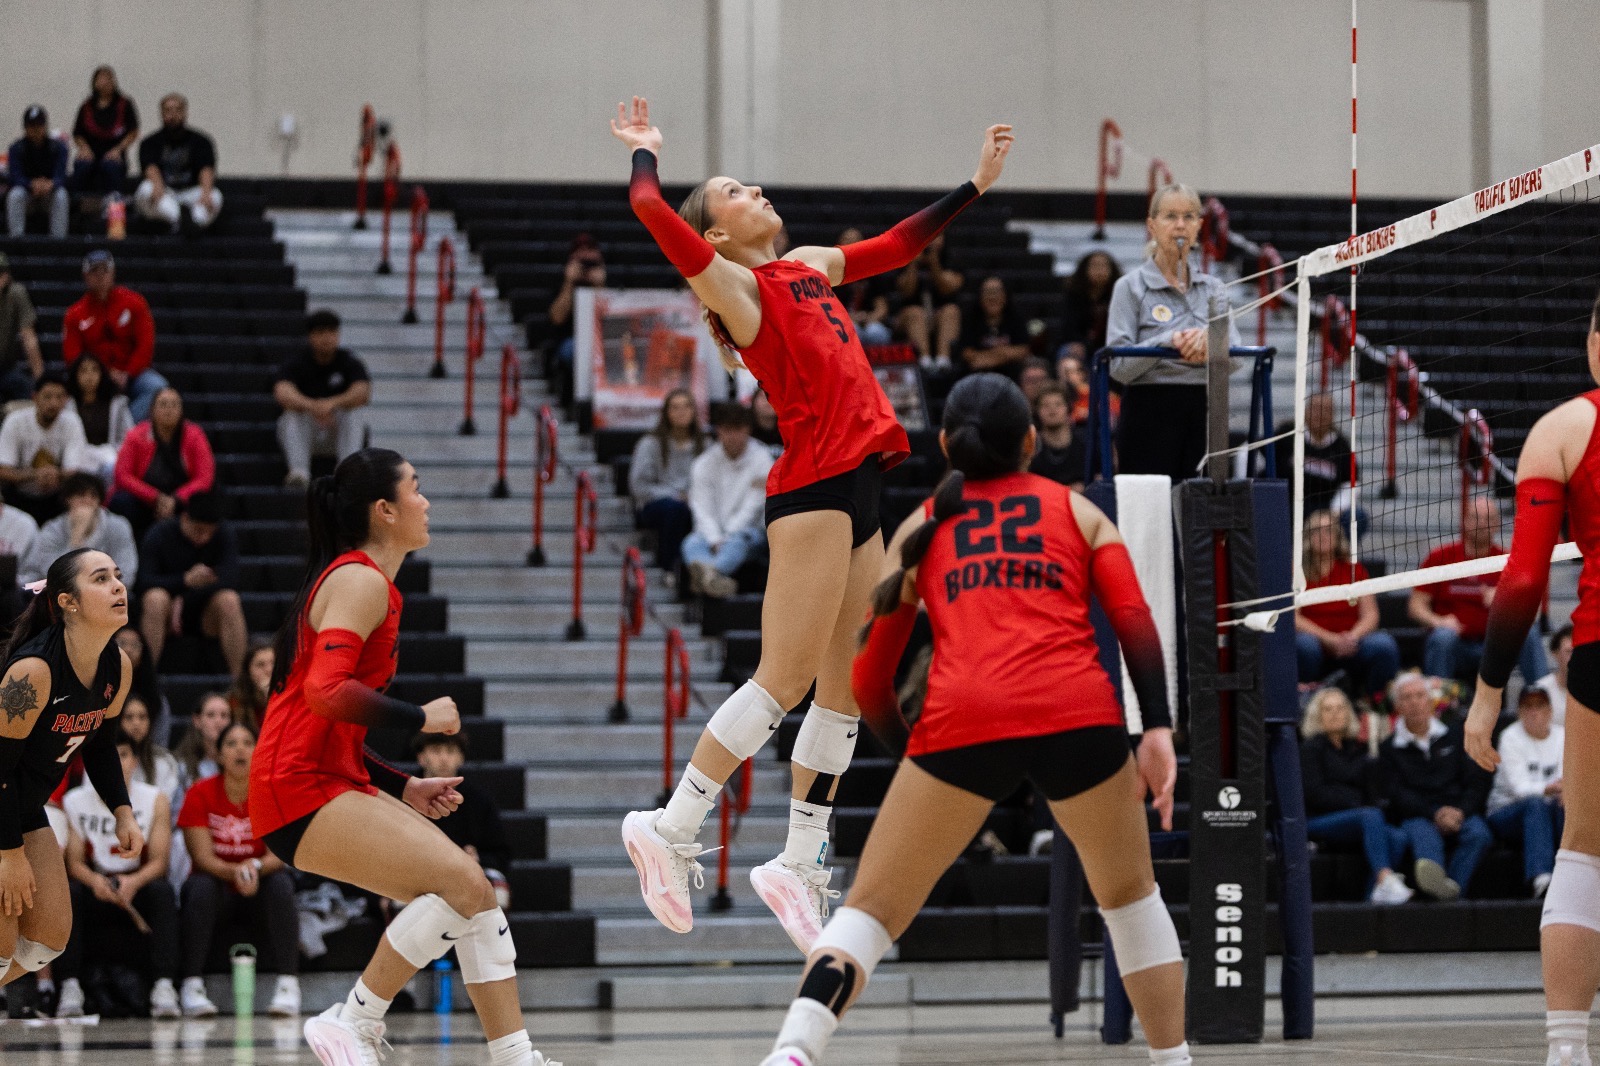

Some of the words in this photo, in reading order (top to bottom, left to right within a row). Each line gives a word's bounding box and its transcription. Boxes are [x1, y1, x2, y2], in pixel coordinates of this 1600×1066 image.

[1584, 149, 1592, 172] P
[1474, 181, 1506, 214] PACIFIC
[1509, 167, 1542, 201] BOXERS
[1430, 209, 1437, 230] P
[820, 303, 849, 343] 5
[954, 495, 1043, 560] 22
[945, 558, 1063, 604] BOXERS
[55, 735, 86, 763] 7
